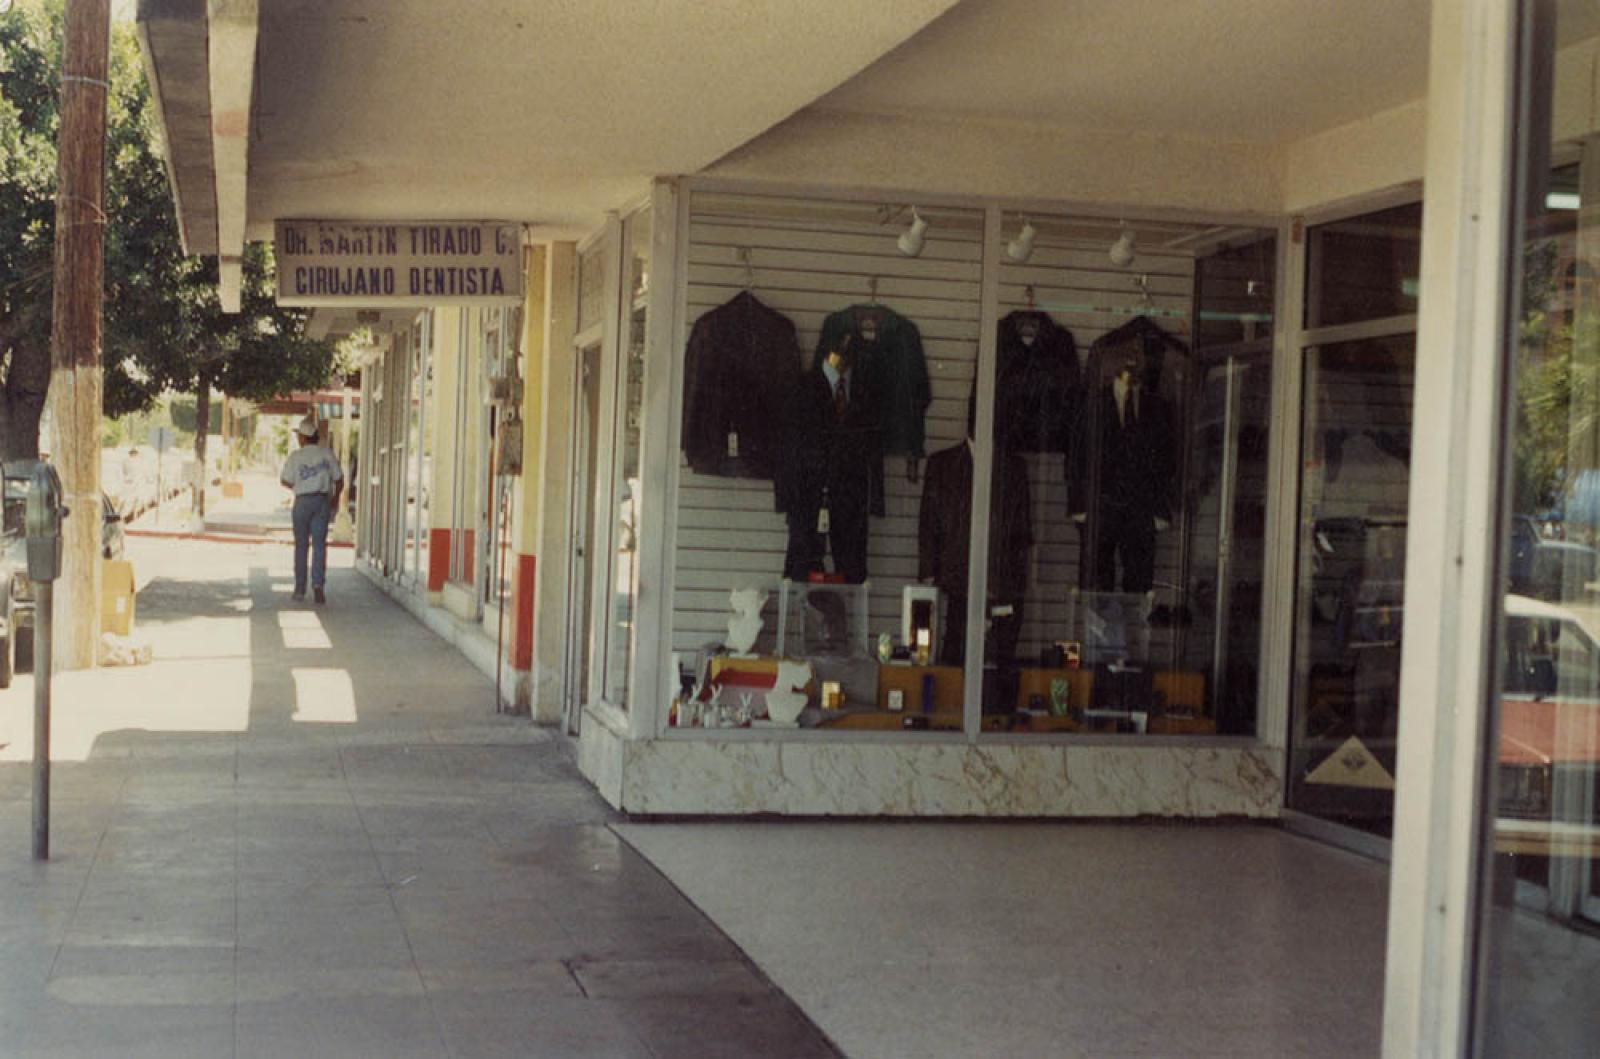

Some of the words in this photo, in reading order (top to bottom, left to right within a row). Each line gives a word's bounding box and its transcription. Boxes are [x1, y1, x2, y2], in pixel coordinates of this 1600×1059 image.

[409, 226, 481, 255] TIRADO
[295, 266, 395, 295] CIRUJANO
[409, 266, 505, 295] DENTISTA
